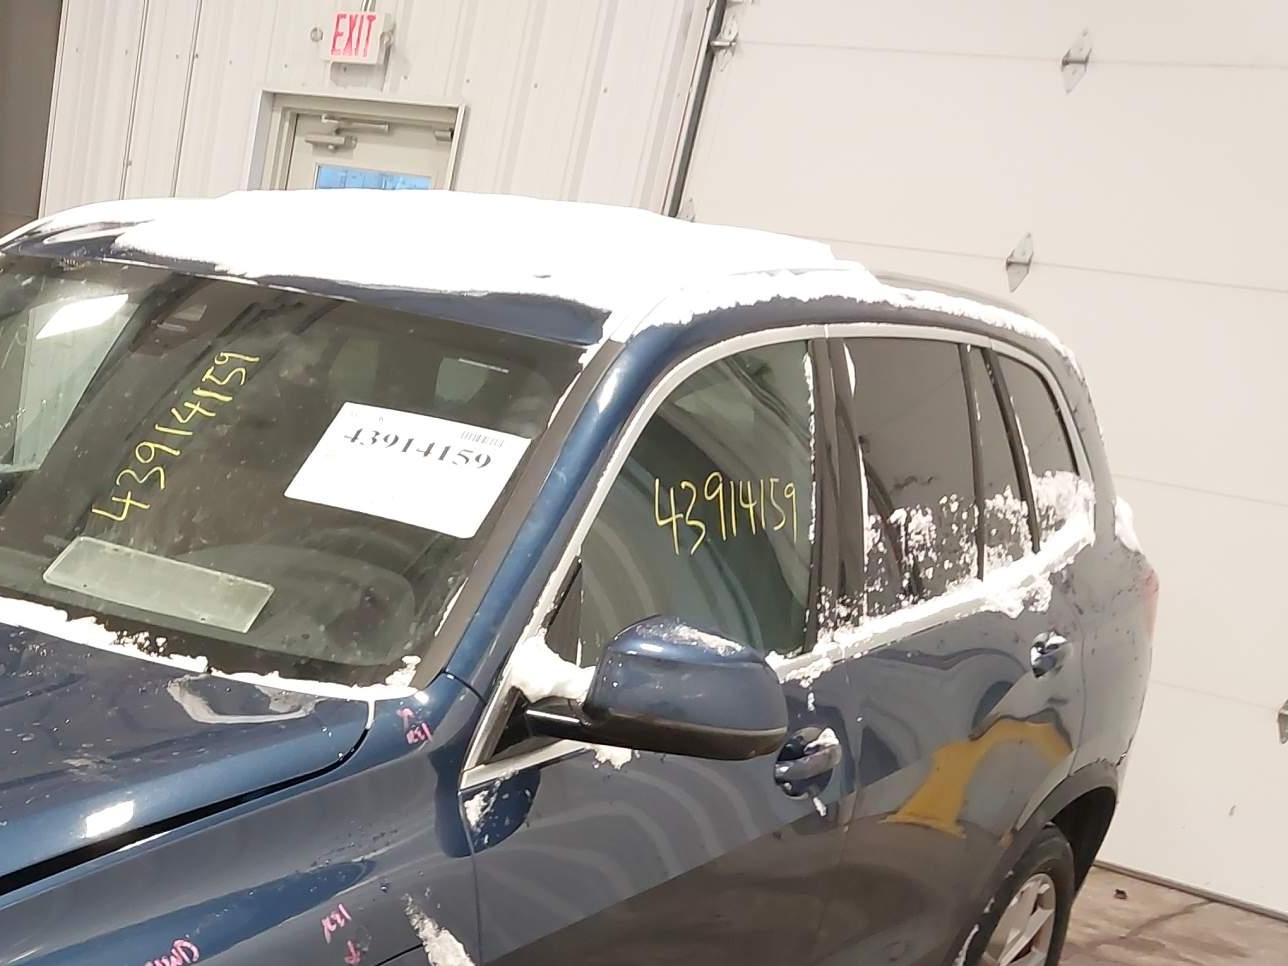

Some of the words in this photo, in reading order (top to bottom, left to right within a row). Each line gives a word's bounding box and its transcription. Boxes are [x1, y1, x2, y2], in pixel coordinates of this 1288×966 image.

[331, 13, 376, 57] EXIT
[91, 351, 260, 522] 43914159
[344, 427, 492, 469] 43914159
[653, 471, 798, 556] 43914159
